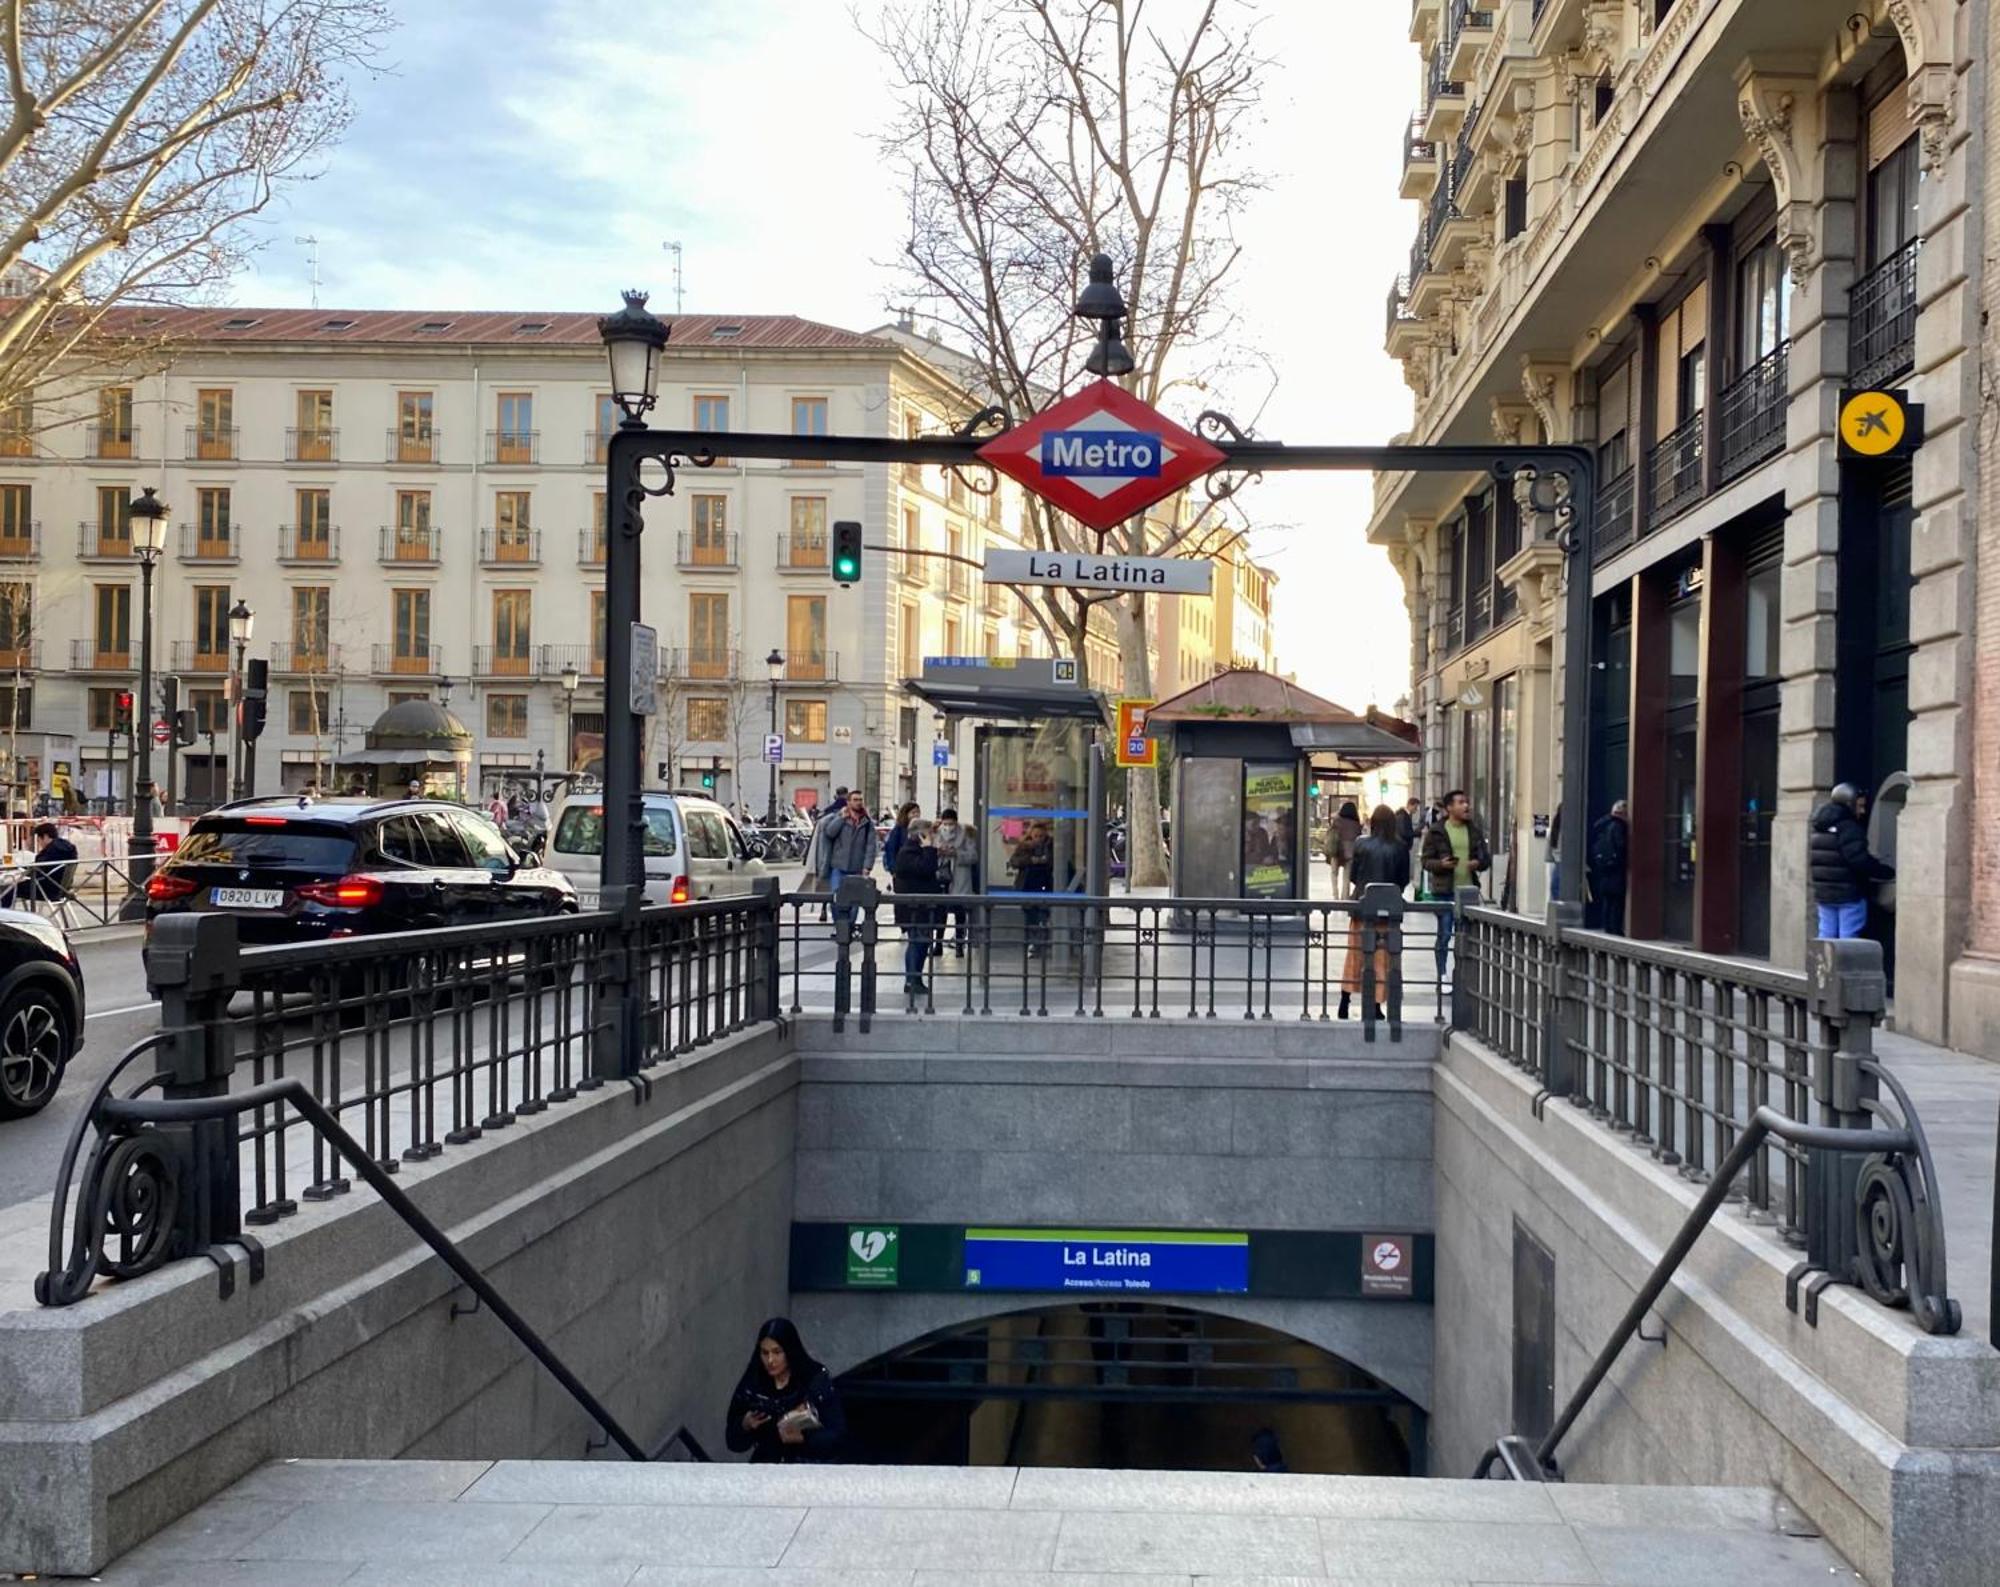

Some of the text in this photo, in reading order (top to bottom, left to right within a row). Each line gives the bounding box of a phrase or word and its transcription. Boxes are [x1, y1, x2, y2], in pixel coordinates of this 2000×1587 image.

[1052, 437, 1153, 468] Metro
[1029, 556, 1165, 584] La Latina
[1129, 742, 1144, 752] 20
[219, 890, 279, 904] 0820 LVK
[1063, 1246, 1152, 1267] La Latina
[1123, 1279, 1151, 1289] Toledo
